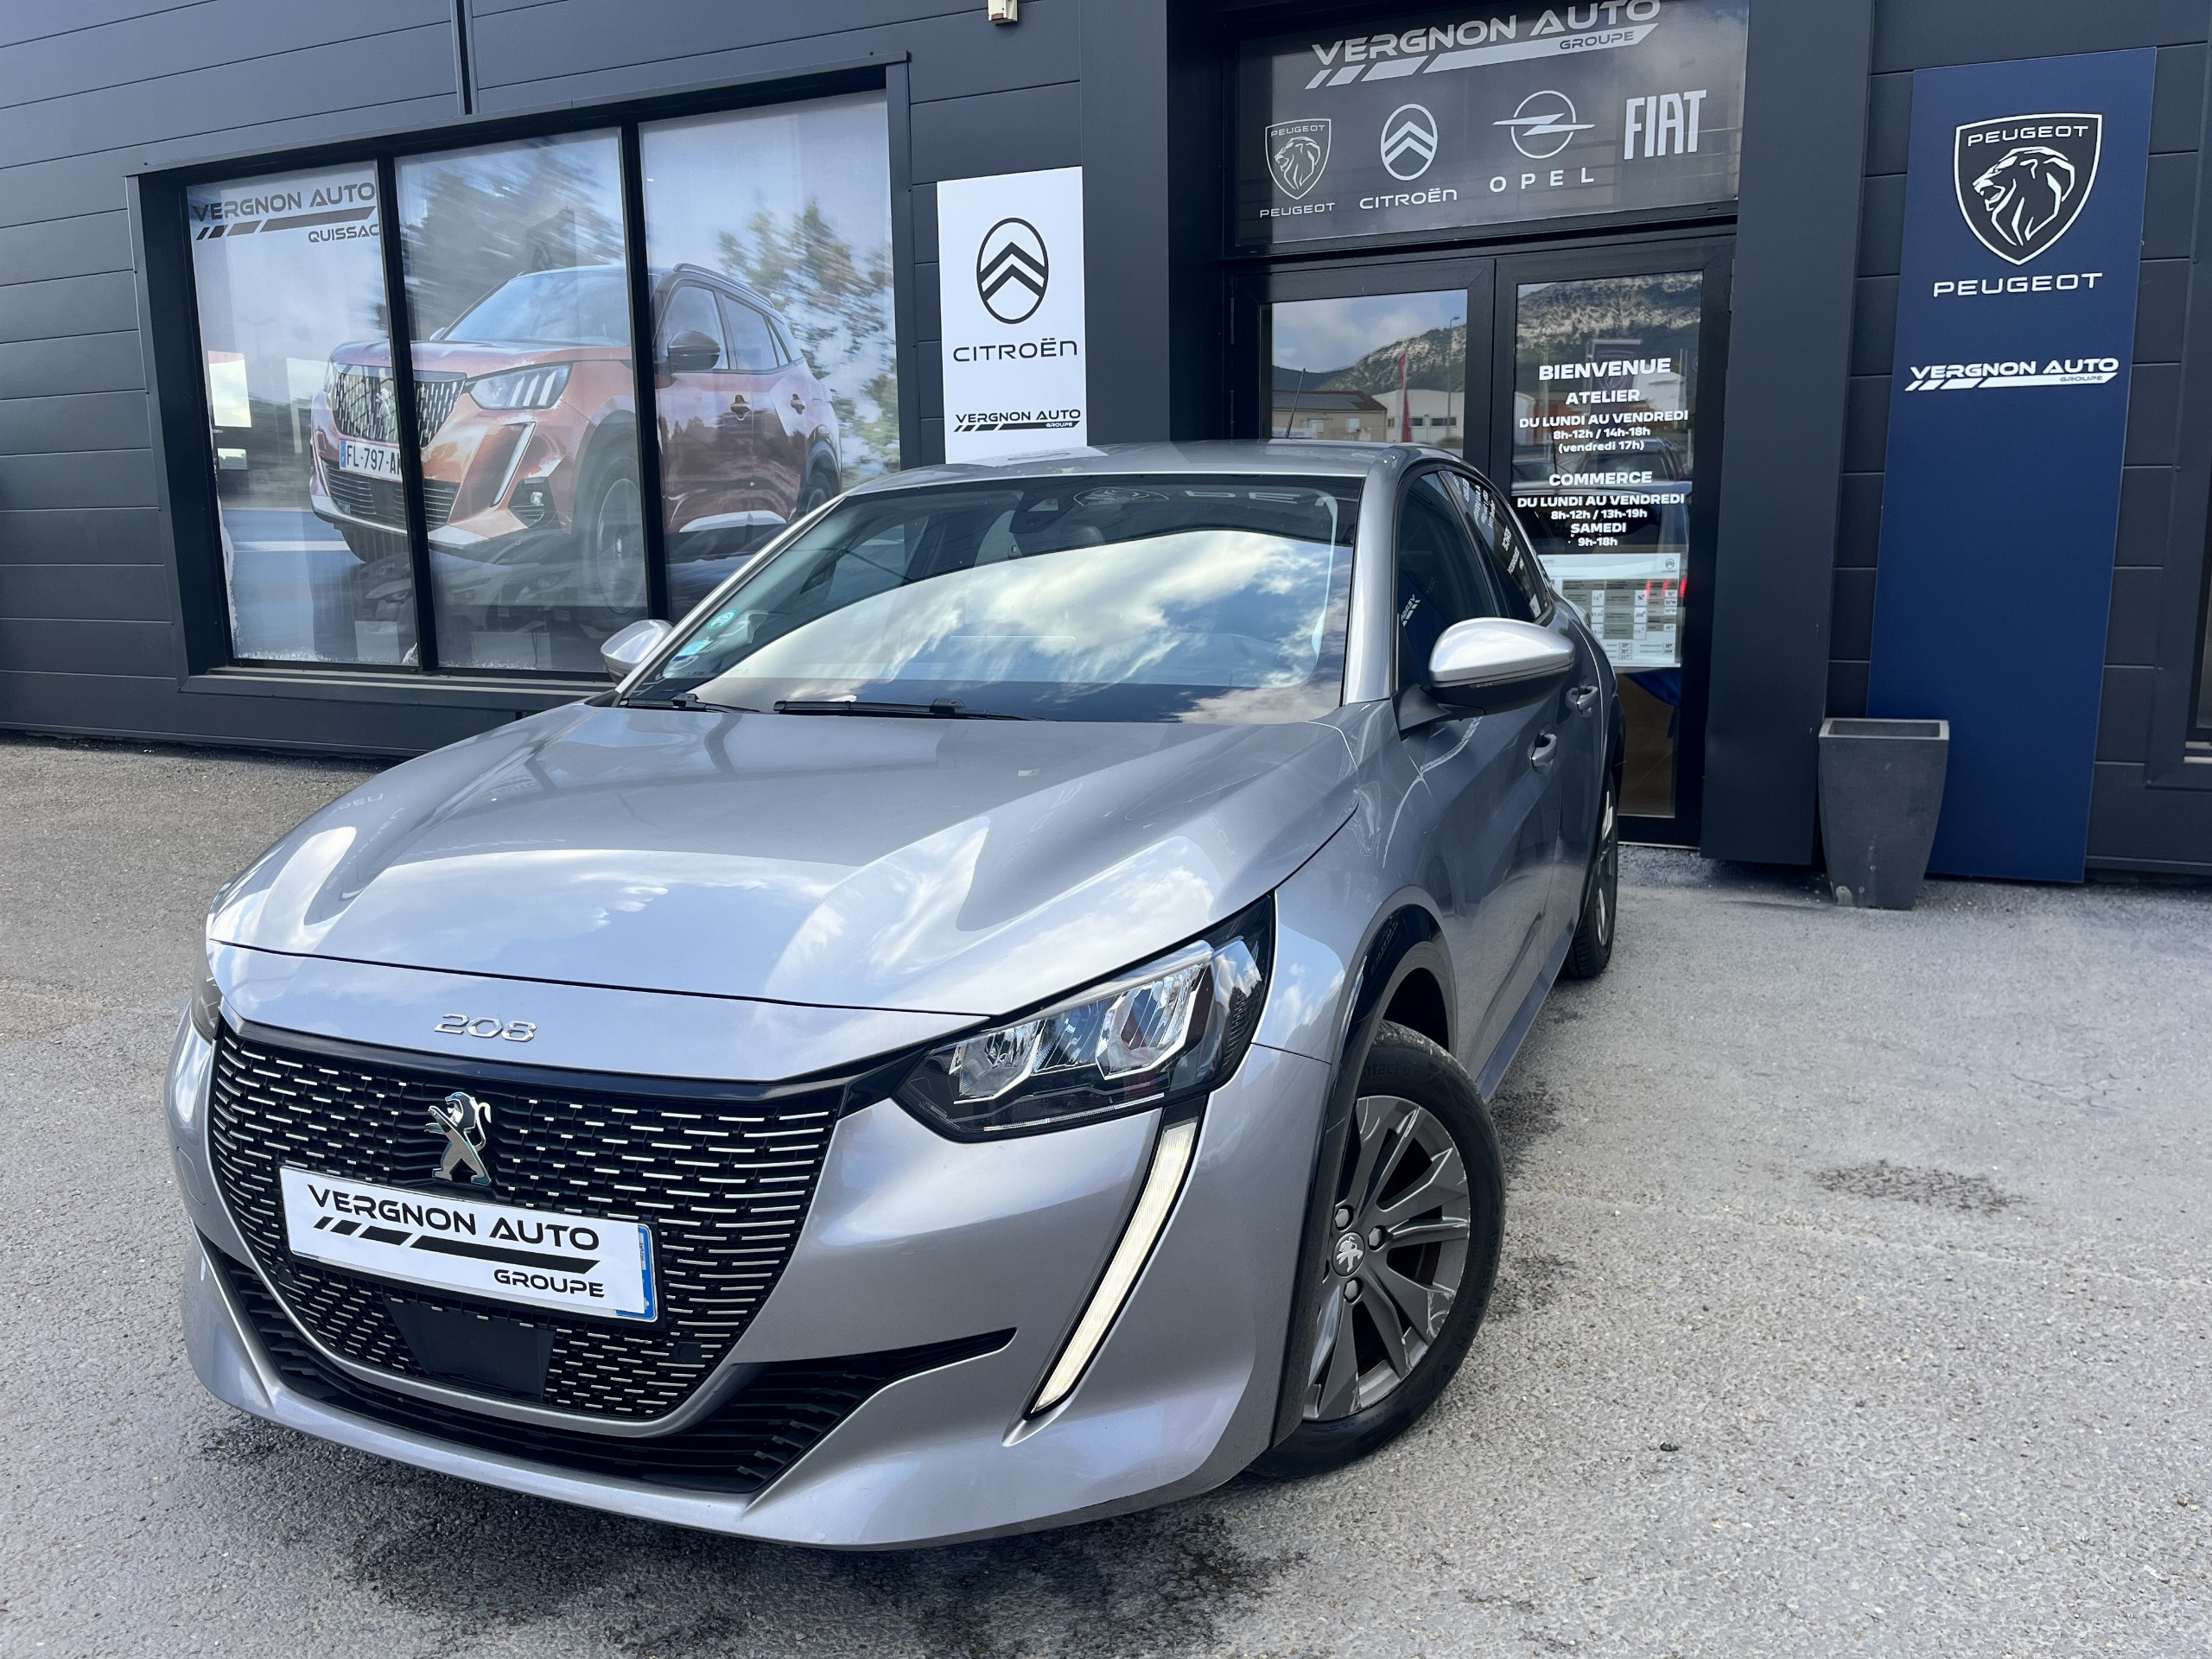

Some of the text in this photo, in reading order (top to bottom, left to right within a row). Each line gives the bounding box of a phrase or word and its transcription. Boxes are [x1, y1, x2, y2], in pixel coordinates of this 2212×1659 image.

[1312, 0, 1661, 66] VERGNON AUTO
[1559, 30, 1635, 50] GROUPE
[1270, 124, 1326, 138] PEUGEOT
[1624, 89, 1707, 161] FIAT
[1967, 125, 2089, 147] PEUGEOT
[1489, 167, 1595, 194] OPEL
[192, 181, 377, 223] VERGNON AUTO
[1259, 201, 1336, 219] PEUGEOT
[308, 224, 381, 244] QUISSAC
[1933, 272, 2104, 297] PEUGEOT
[1538, 358, 1672, 381] BIENVENUE
[1910, 357, 2120, 380] VERGNON AUTO
[1565, 389, 1641, 405] ATELIER
[955, 409, 1081, 424] VERGNON AUTO
[1519, 410, 1688, 429] DU LUNDI AU VENDREDI
[1553, 429, 1593, 440] 8h-12h
[1603, 427, 1651, 438] 14h-18h
[1558, 440, 1645, 454] (vendredi 17h)
[1548, 471, 1653, 486] COMMERCE
[1517, 493, 1685, 508] DU LUNDI AU VENDREDI
[1550, 510, 1591, 520] 8h-12h
[1601, 508, 1648, 519] 13h-19h
[1570, 522, 1627, 534] SAMEDI
[1578, 537, 1618, 547] 9h-18h
[434, 1013, 537, 1042] 208
[307, 1183, 601, 1251] VERGNON AUTO
[493, 1269, 606, 1299] GROUPE
